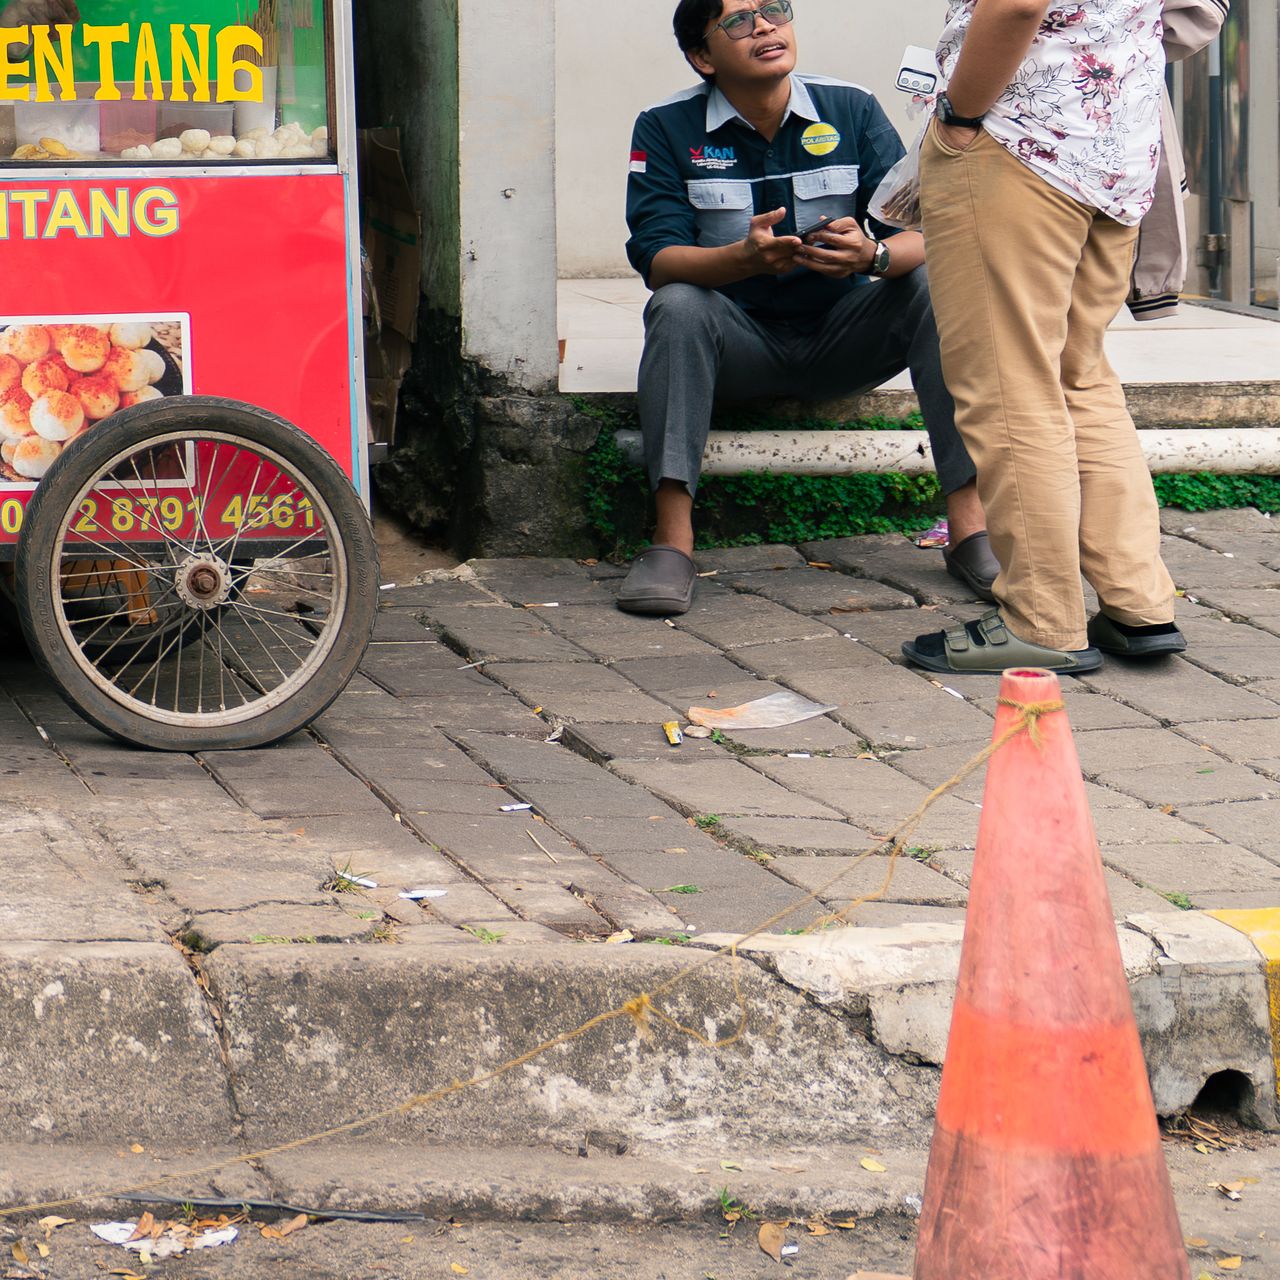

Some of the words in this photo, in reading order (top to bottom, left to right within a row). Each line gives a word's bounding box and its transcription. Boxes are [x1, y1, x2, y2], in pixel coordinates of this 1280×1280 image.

[704, 146, 734, 159] KAN
[0, 497, 98, 533] 02
[110, 496, 203, 532] 8791
[220, 494, 316, 529] 4561
